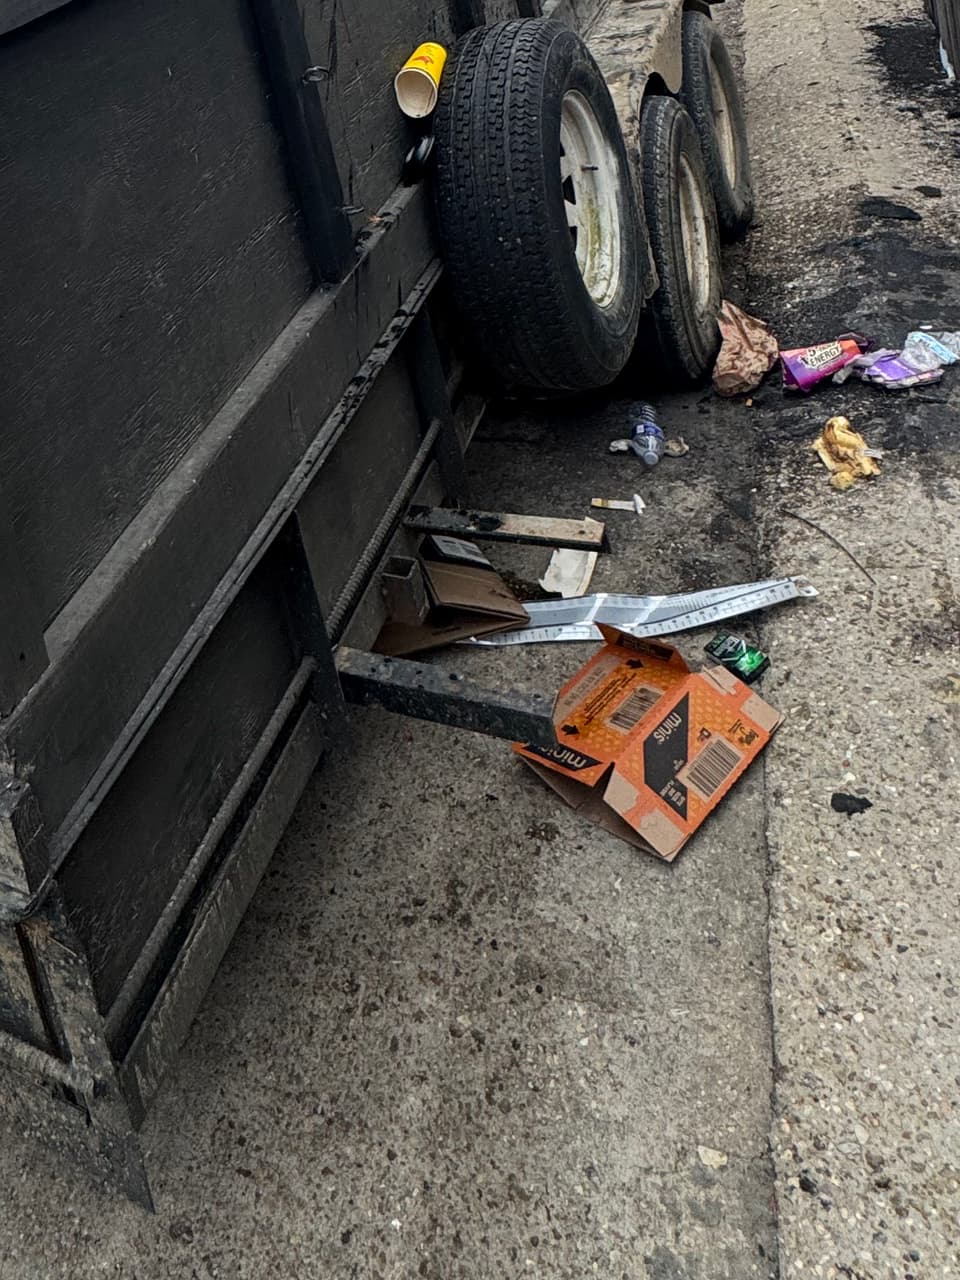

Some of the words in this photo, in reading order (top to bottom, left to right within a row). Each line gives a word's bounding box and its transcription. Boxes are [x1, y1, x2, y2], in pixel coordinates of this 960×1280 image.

[810, 346, 840, 368] ENERGY
[653, 712, 682, 744] minis
[539, 745, 587, 768] min
